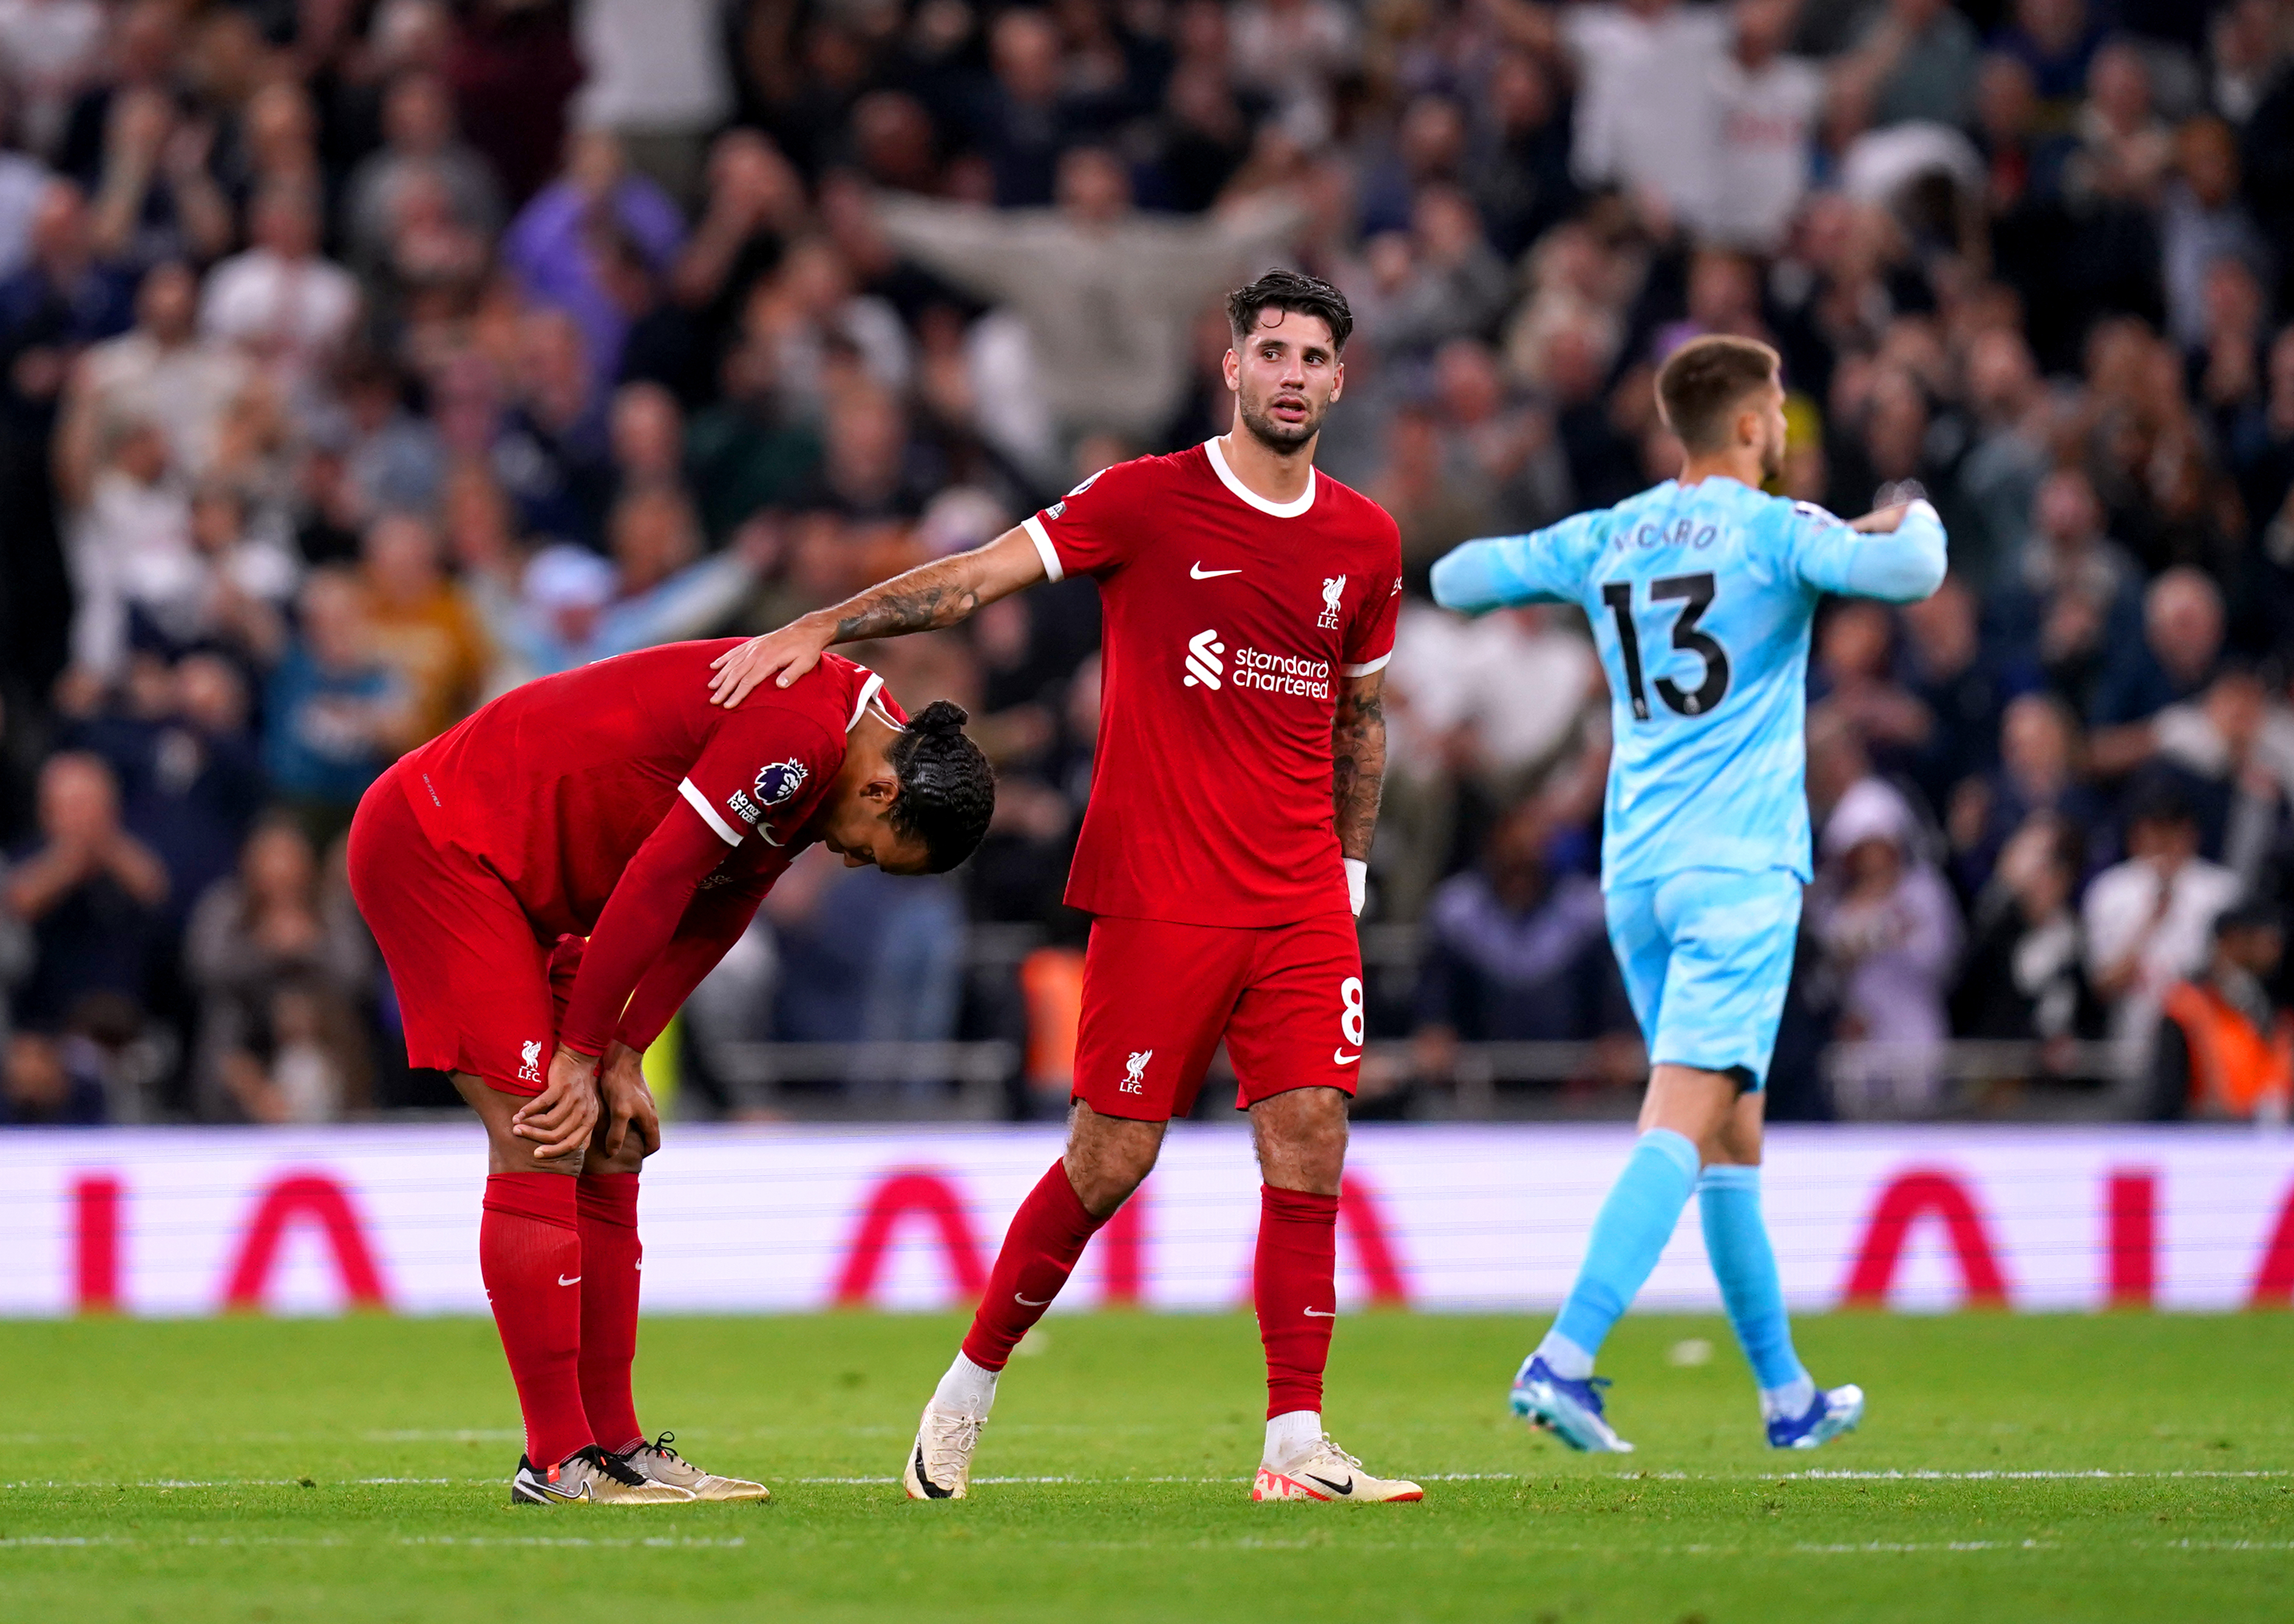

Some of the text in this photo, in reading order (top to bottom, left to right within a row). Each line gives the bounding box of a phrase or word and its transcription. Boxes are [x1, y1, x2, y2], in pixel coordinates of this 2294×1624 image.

[1603, 572, 1728, 720] 13
[1235, 647, 1329, 678] standard
[1233, 668, 1329, 699] chartered
[733, 789, 748, 806] No
[1341, 977, 1364, 1046] 8
